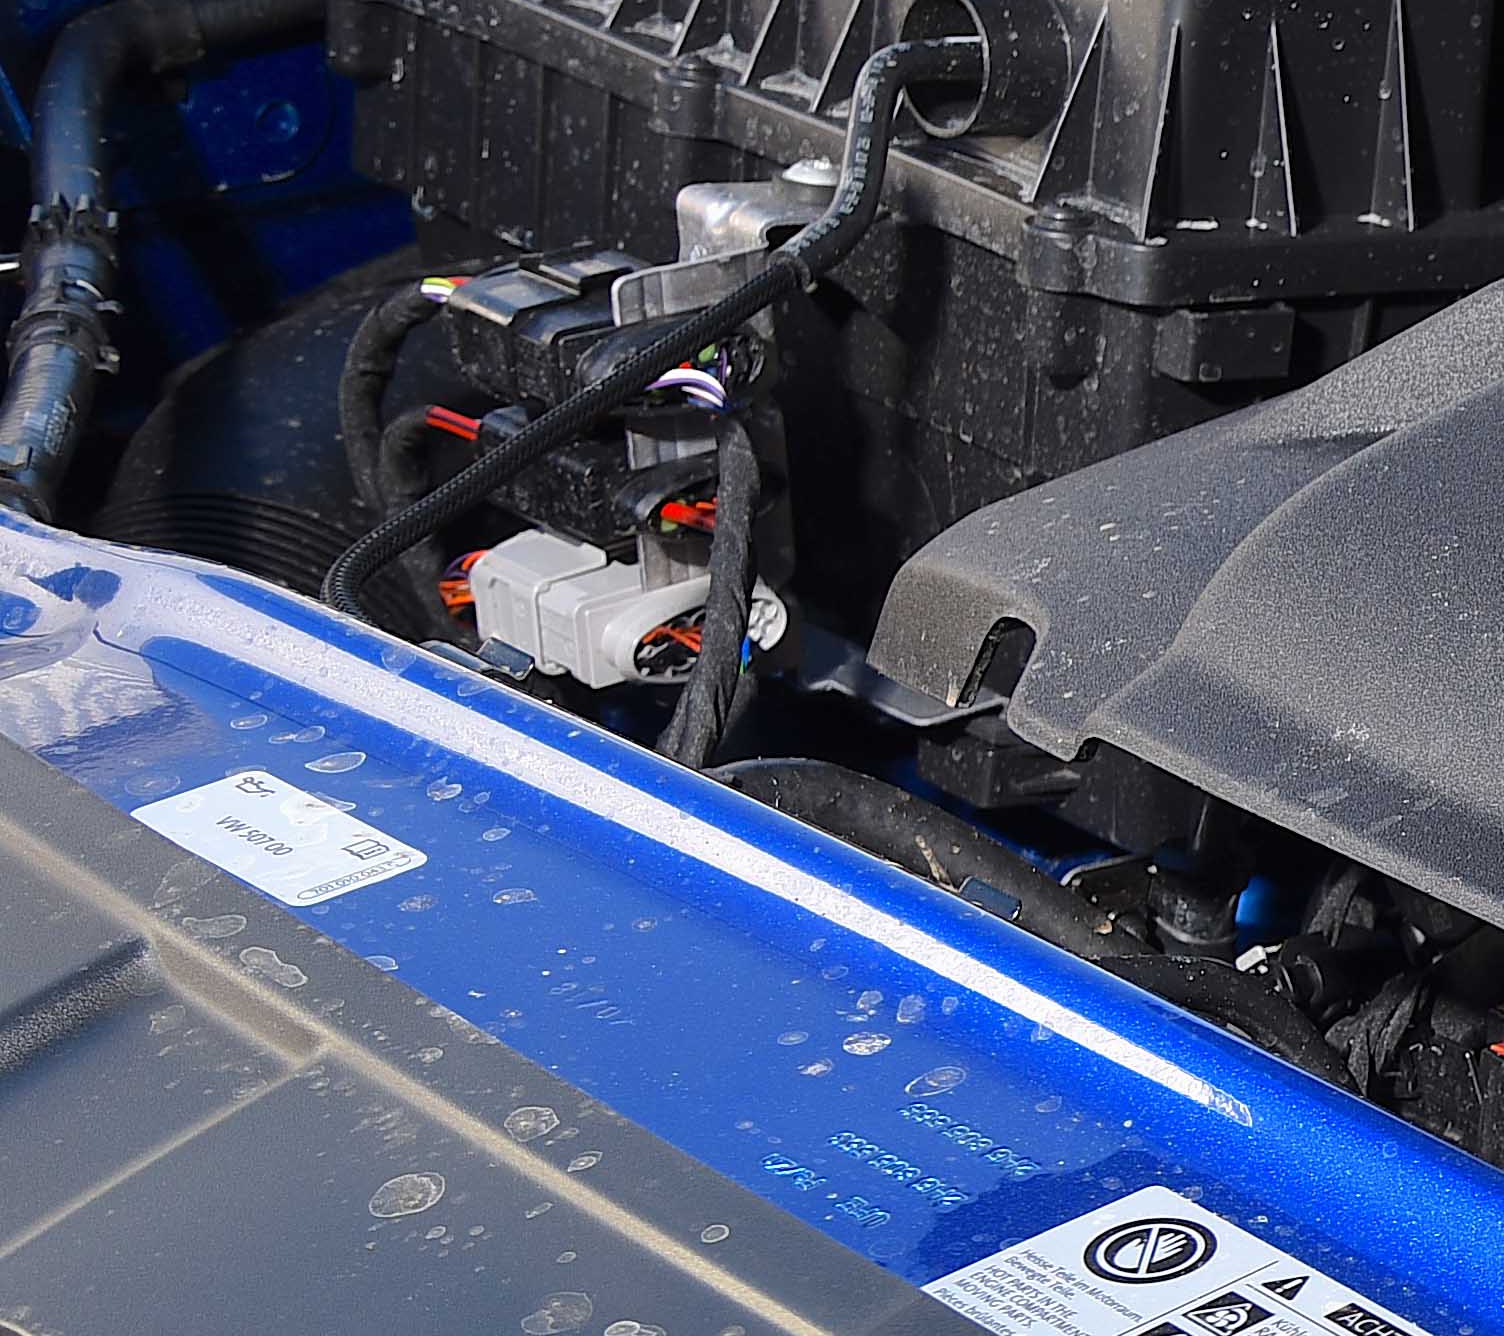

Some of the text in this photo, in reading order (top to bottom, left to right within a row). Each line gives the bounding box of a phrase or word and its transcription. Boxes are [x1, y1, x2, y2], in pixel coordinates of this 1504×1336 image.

[212, 815, 296, 857] VW 507 00
[950, 1277, 1006, 1308] MOVING
[966, 1270, 1018, 1298] ENGINE
[981, 1264, 1079, 1319] HOT PARTS IN THE
[1070, 1279, 1094, 1291] im
